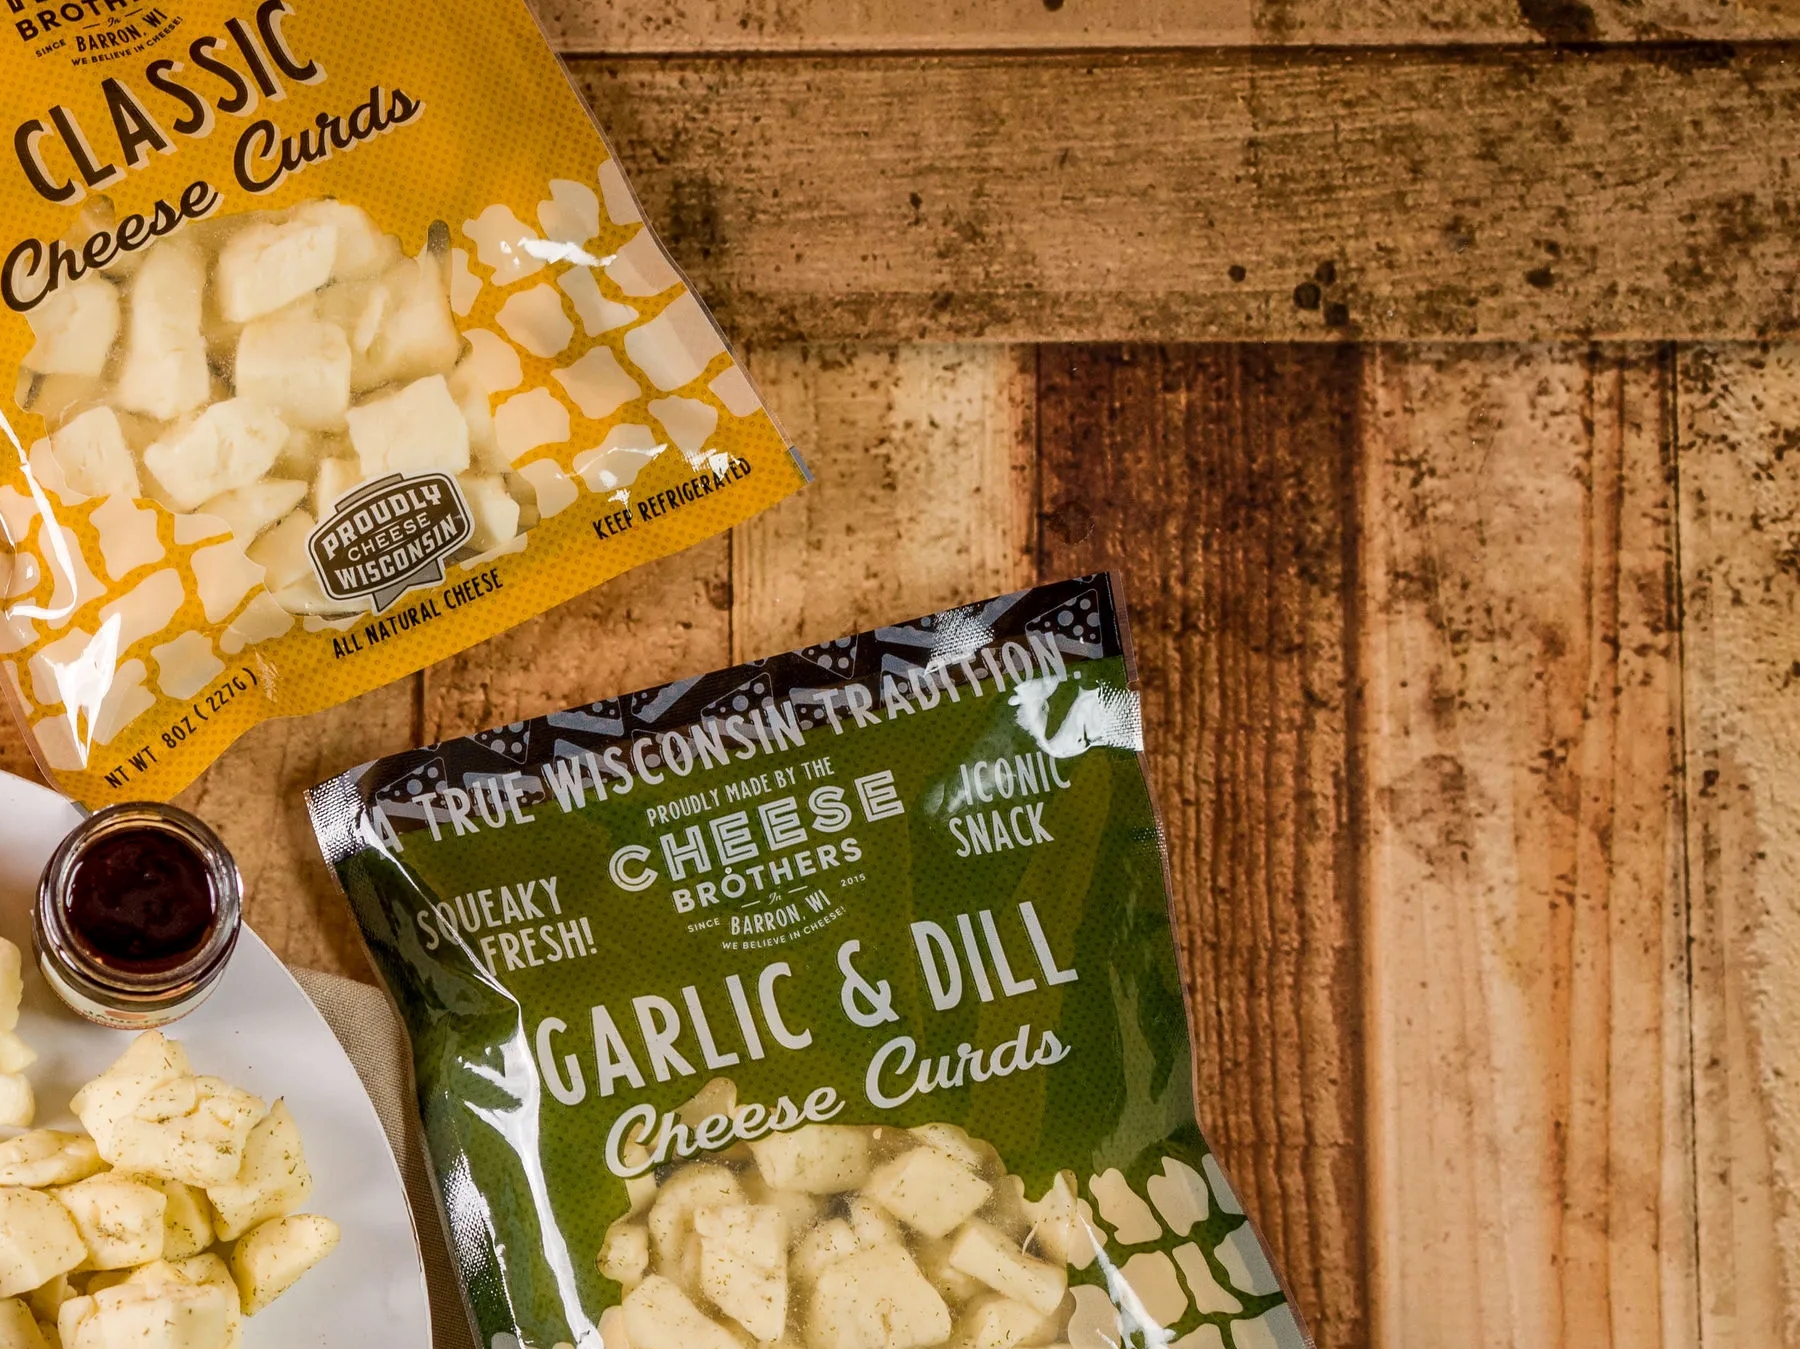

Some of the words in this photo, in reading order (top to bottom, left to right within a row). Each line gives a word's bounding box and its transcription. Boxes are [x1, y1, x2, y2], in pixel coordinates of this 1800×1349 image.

[35, 38, 67, 58] SINCE
[71, 58, 88, 67] WE
[91, 49, 132, 64] BELIEVE
[134, 44, 145, 54] IN
[146, 16, 184, 47] CHEESE!
[142, 7, 168, 28] WI
[12, 0, 324, 204] CLASSIC
[1, 181, 220, 313] Cheese
[233, 86, 423, 194] Curds
[321, 484, 442, 560] PROUDLY
[335, 515, 458, 590] WISCONSIN
[348, 512, 431, 562] CHEESE
[592, 509, 633, 540] KEEP
[333, 634, 364, 660] ALL
[365, 598, 441, 646] NATURAL
[443, 567, 504, 610] CHEESE
[104, 765, 130, 789] NT
[128, 745, 158, 773] WT
[161, 715, 198, 749] 8OZ
[412, 770, 536, 843] TRUE
[542, 698, 806, 814] WISCONSIN
[813, 630, 1082, 736] TRADITION.
[646, 790, 721, 827] PROUDLY
[725, 773, 769, 804] MADE
[774, 766, 797, 789] BY
[800, 757, 835, 781] THE
[959, 750, 1072, 807] ICONIC
[608, 769, 906, 893] CHEESE
[948, 801, 1054, 858] SNACK
[671, 838, 863, 914] BROTHERS
[687, 917, 721, 933] SINCE
[840, 873, 867, 888] 2015
[805, 889, 832, 914] WI
[417, 876, 562, 950] SQUEAKY
[480, 917, 598, 977] FRESH!
[722, 940, 738, 950] WE
[742, 935, 787, 950] BELIEVE
[789, 930, 801, 941] IN
[803, 905, 847, 935] CHEESE!
[535, 961, 813, 1107] GARLIC
[836, 939, 900, 1029] &
[910, 901, 1079, 1012] DILL
[605, 1086, 846, 1179] Cheese
[864, 1024, 1073, 1110] Curds
